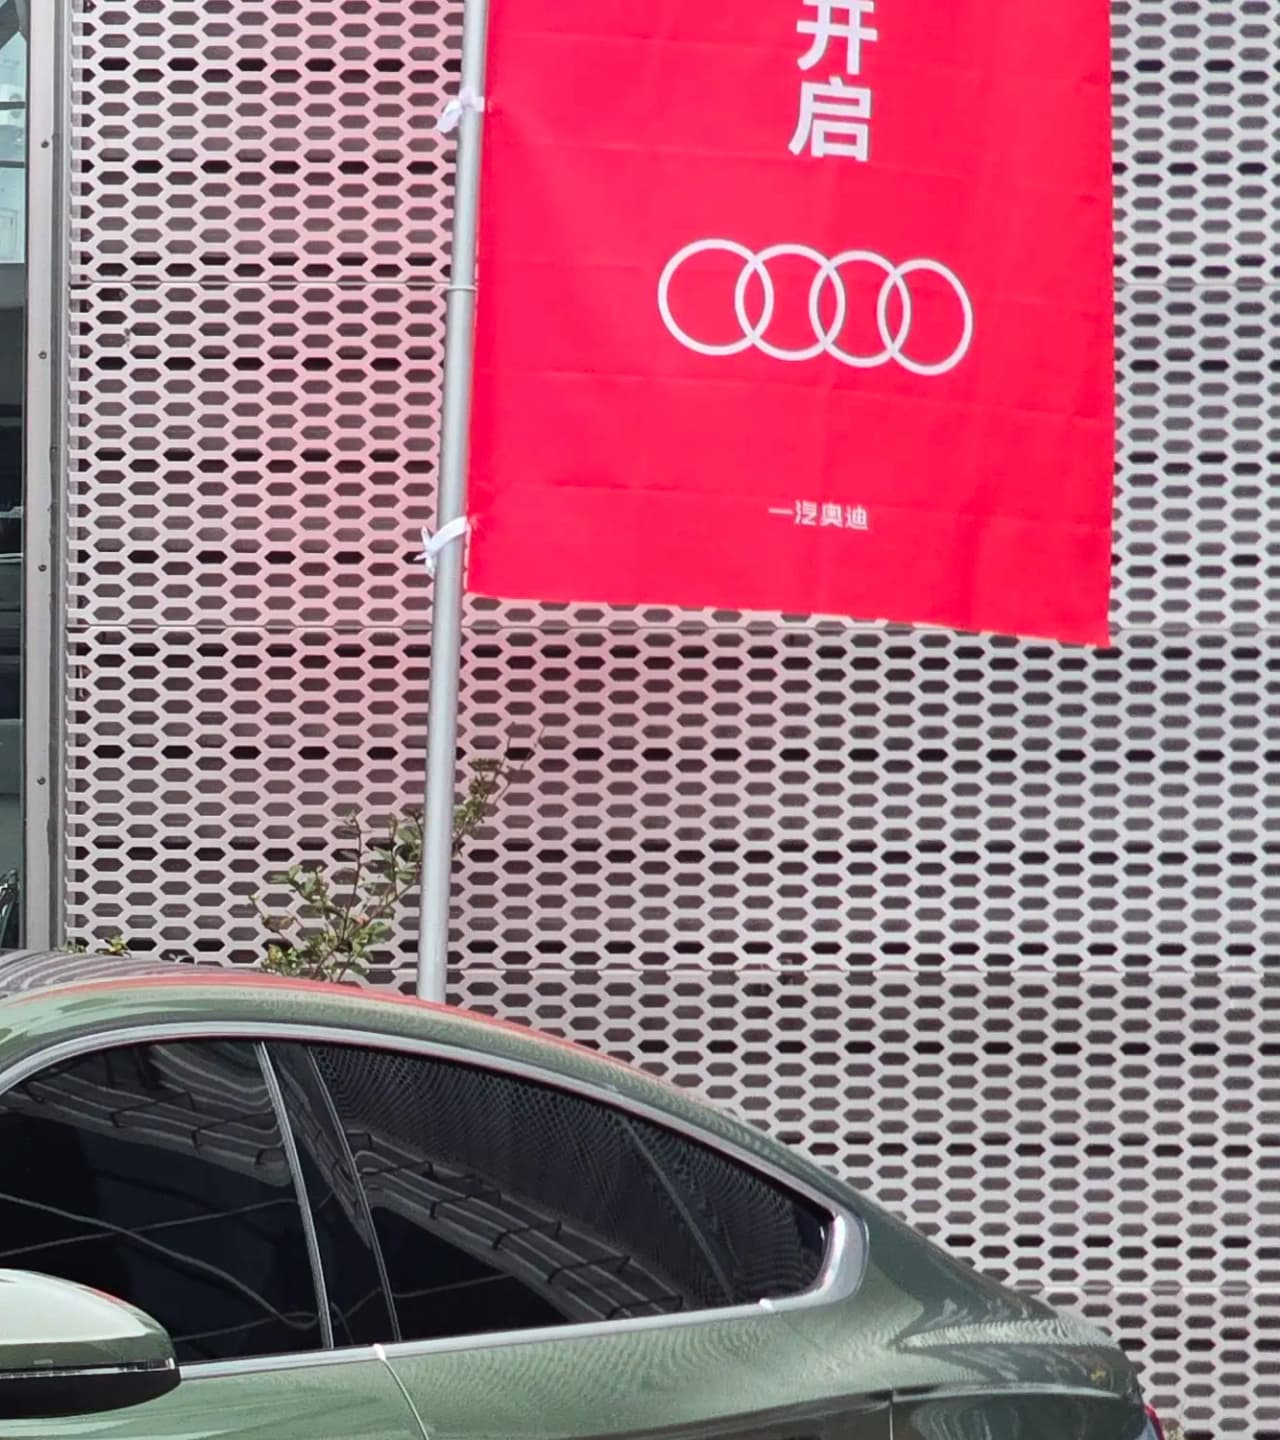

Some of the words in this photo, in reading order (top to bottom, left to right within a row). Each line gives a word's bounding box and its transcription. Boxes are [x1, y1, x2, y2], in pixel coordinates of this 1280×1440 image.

[788, 0, 878, 162] 开启
[768, 499, 869, 531] 一汽奥迪
